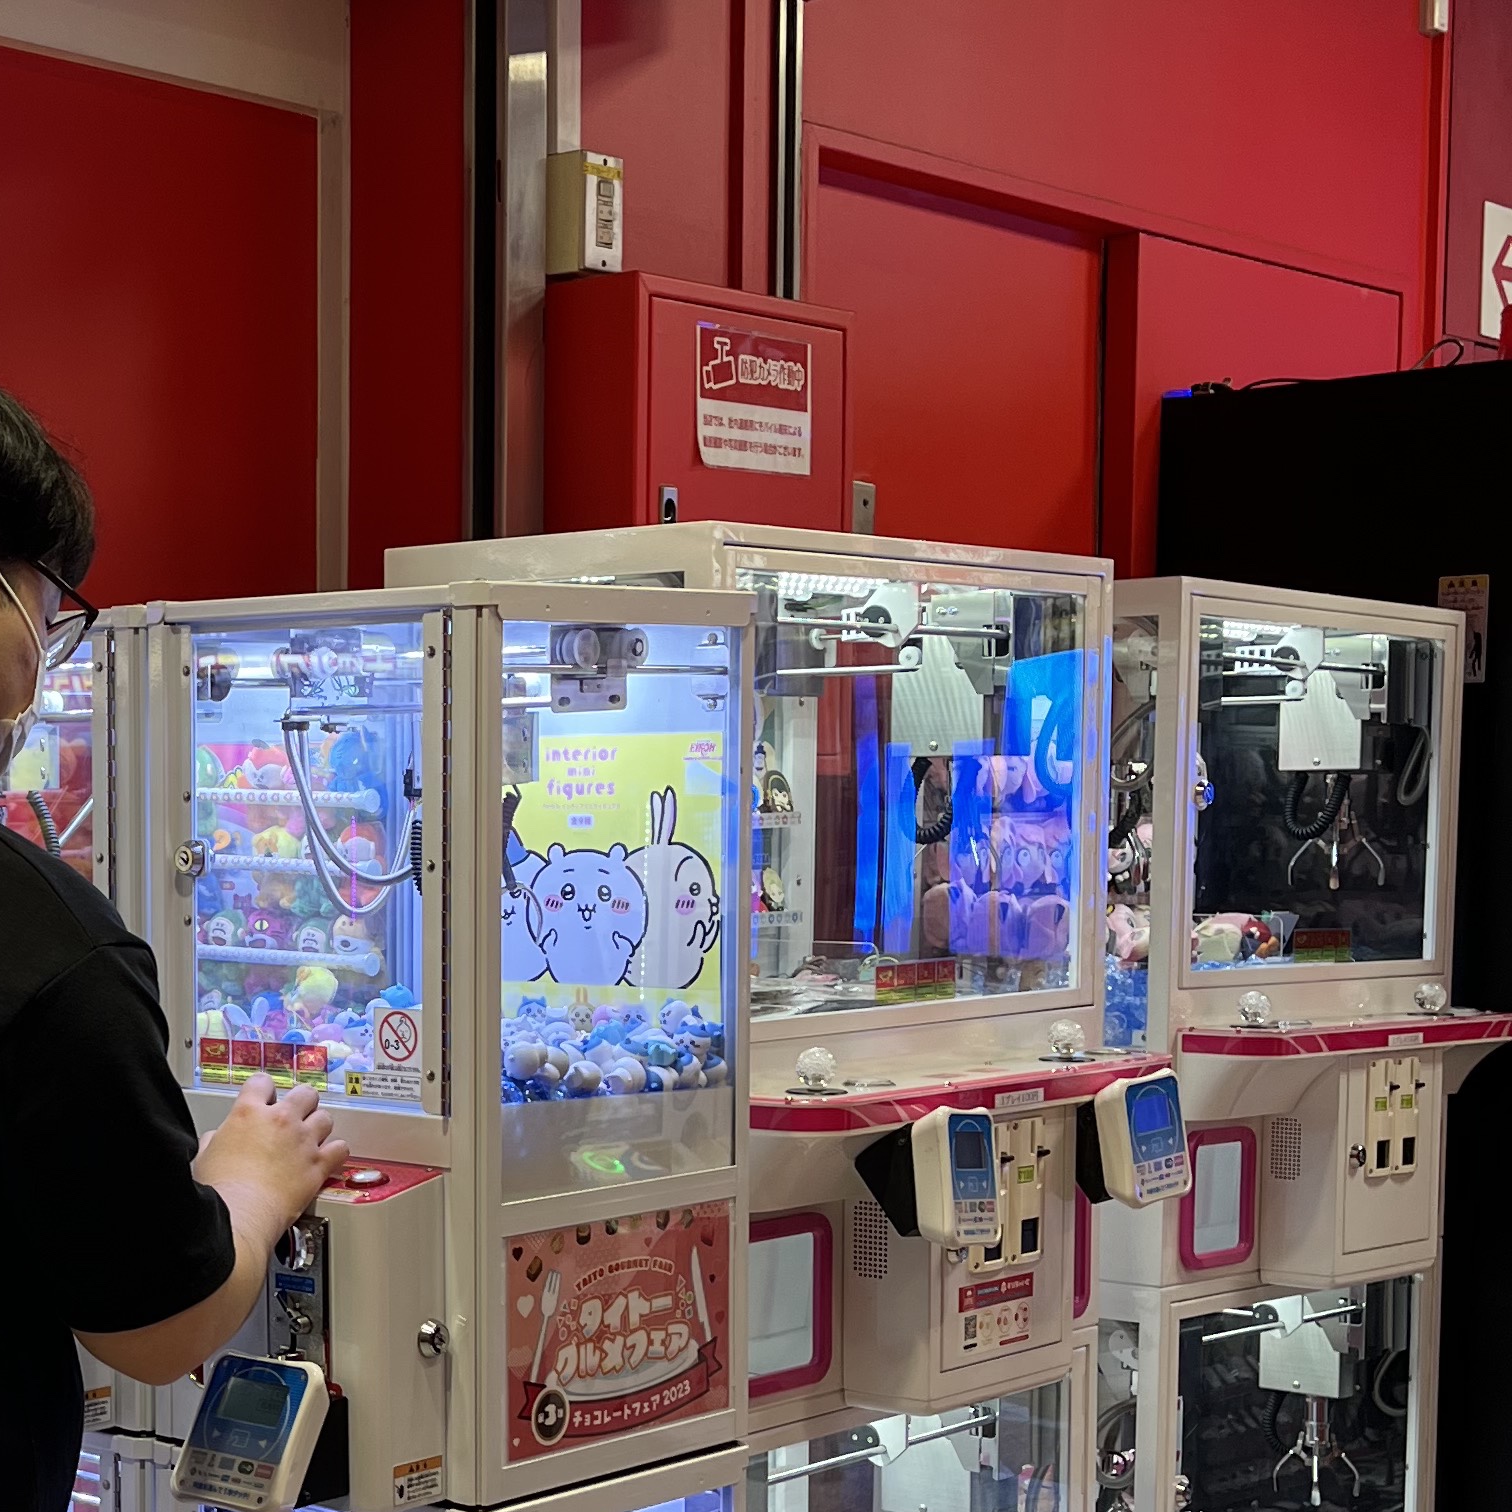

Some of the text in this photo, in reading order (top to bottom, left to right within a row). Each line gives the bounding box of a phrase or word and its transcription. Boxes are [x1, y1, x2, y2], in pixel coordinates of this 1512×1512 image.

[544, 747, 617, 762] interior
[567, 766, 595, 777] mini
[546, 778, 616, 801] figures
[574, 1257, 676, 1292] TAITO GOURMET FAIR
[579, 1289, 674, 1339] タイトー
[555, 1321, 691, 1388] グルメフェア
[572, 1379, 692, 1428] チョコレートフェア 2023
